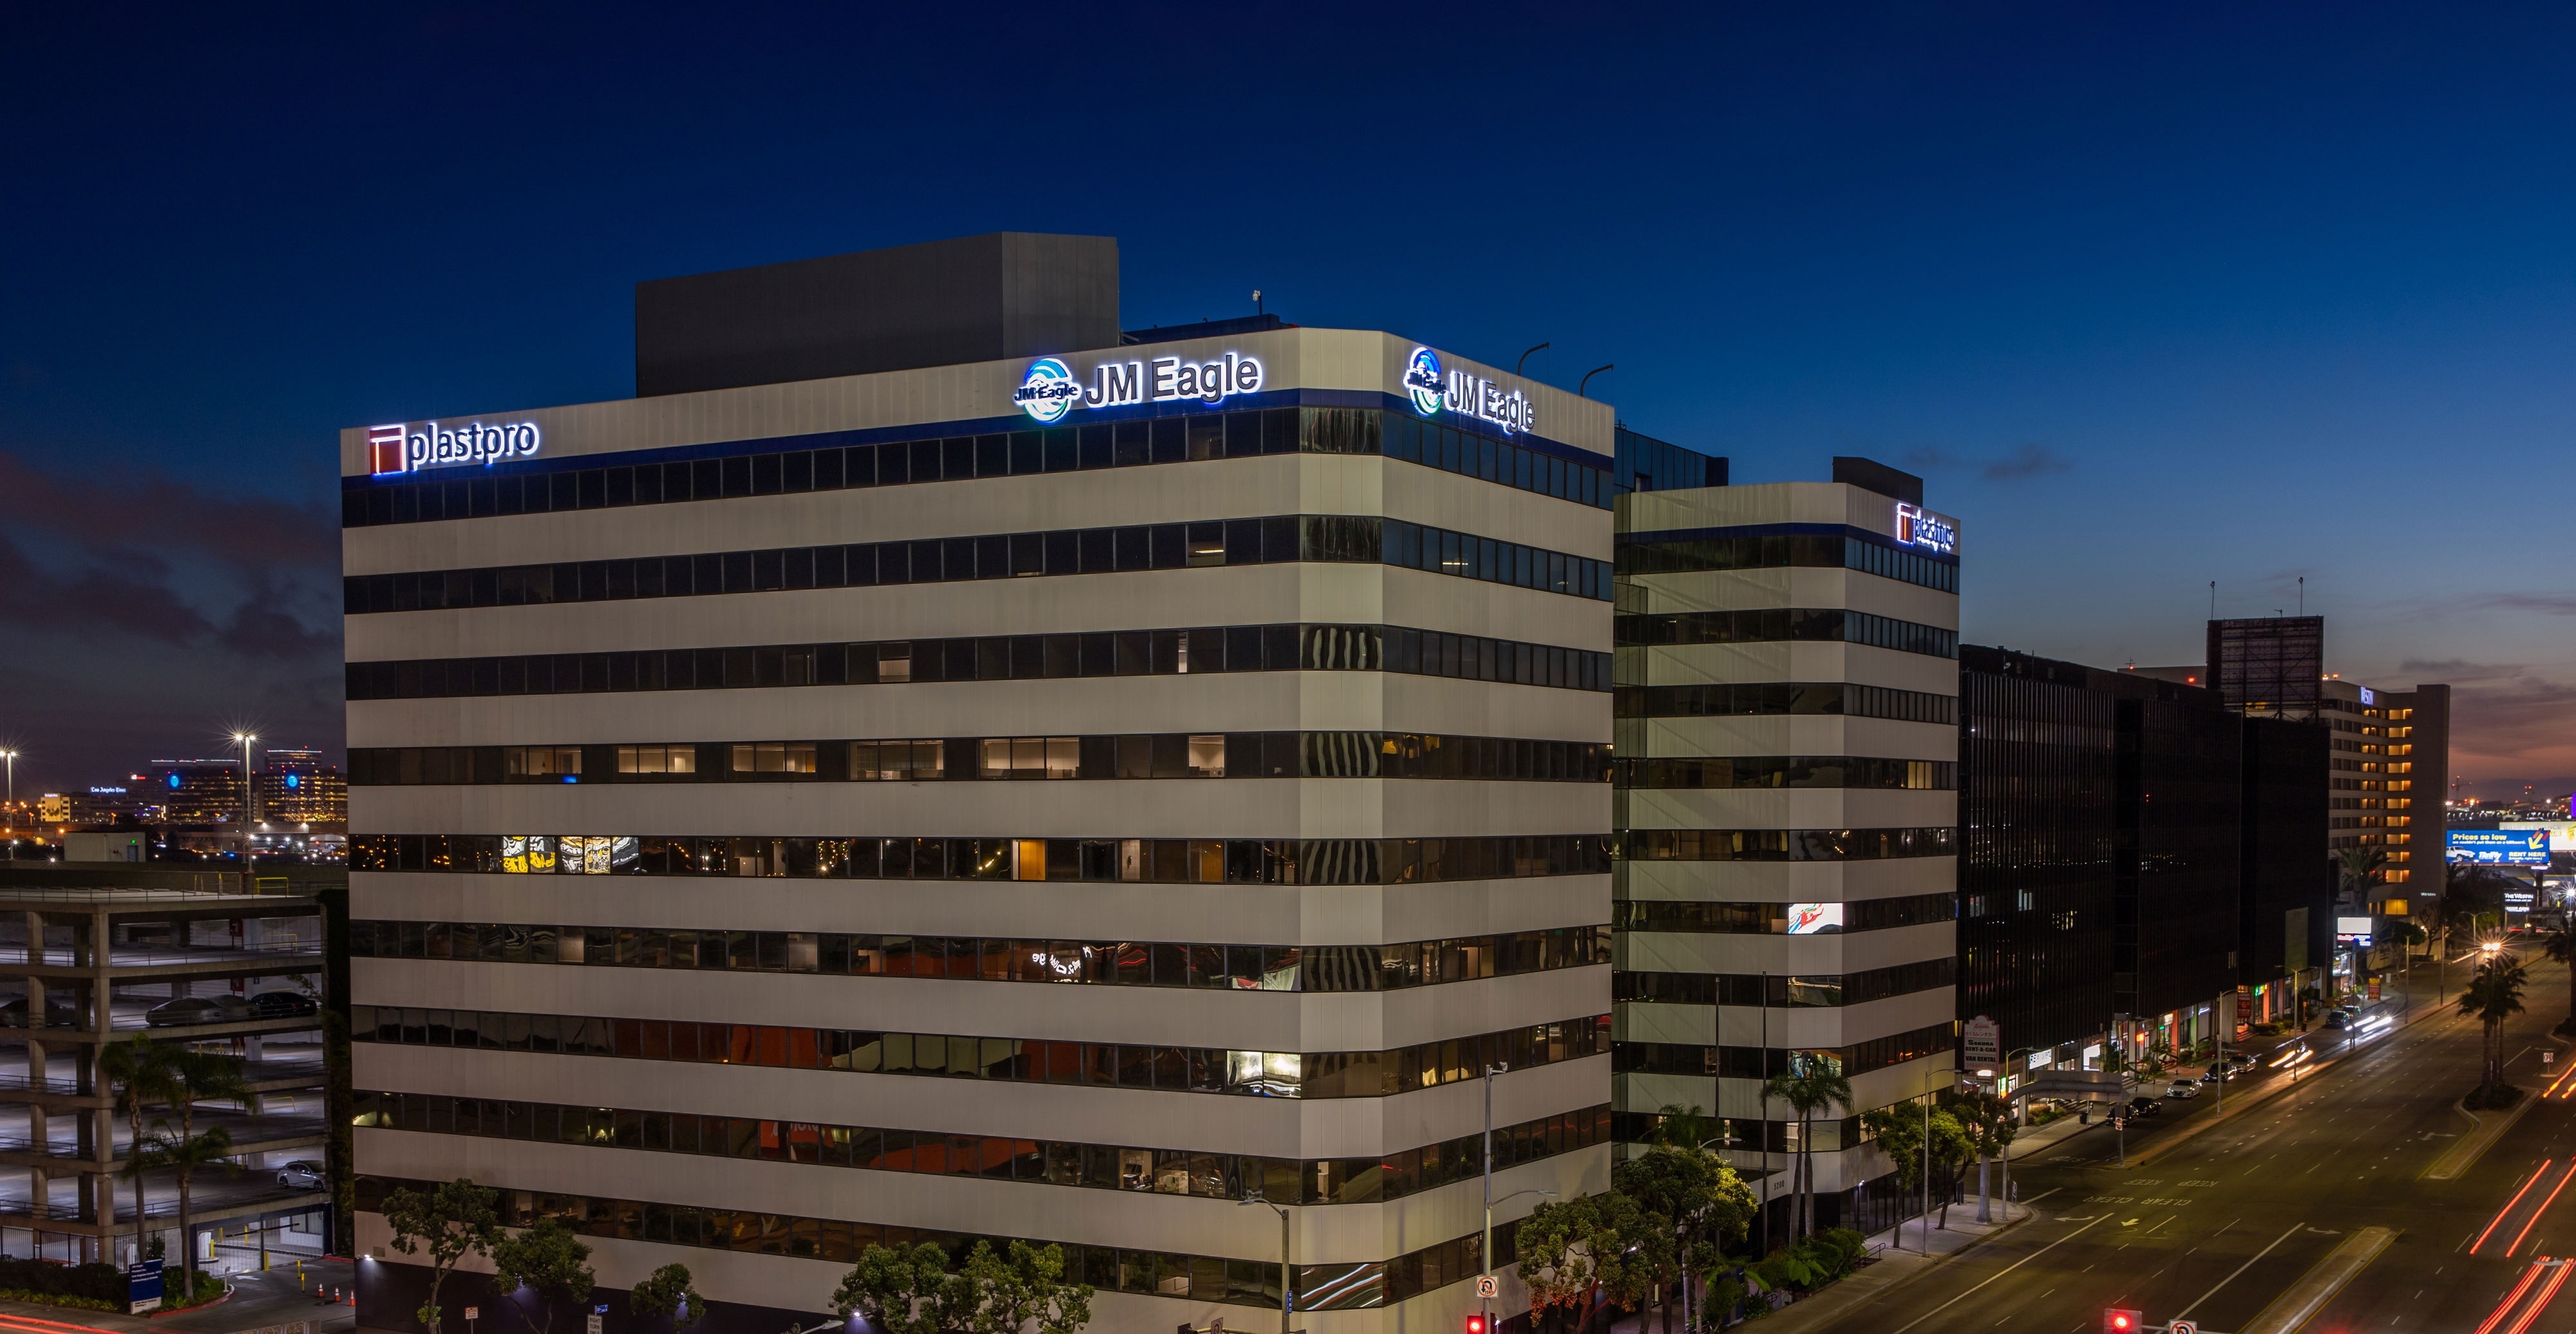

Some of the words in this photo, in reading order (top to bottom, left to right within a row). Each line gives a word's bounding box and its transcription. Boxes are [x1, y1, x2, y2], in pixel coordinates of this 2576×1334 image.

[1085, 364, 1139, 405] JM
[1151, 354, 1259, 403] Eagle
[1014, 386, 1036, 401] JM
[1037, 383, 1078, 399] Eagle
[1449, 372, 1478, 413] JM
[1483, 381, 1535, 434] Eagle
[408, 423, 539, 471] plastpro
[1774, 1179, 1785, 1190] 5200
[2177, 1179, 2220, 1188] KEEP
[2083, 1196, 2134, 1204] CLEAR
[2140, 1197, 2192, 1206] CLEAR
